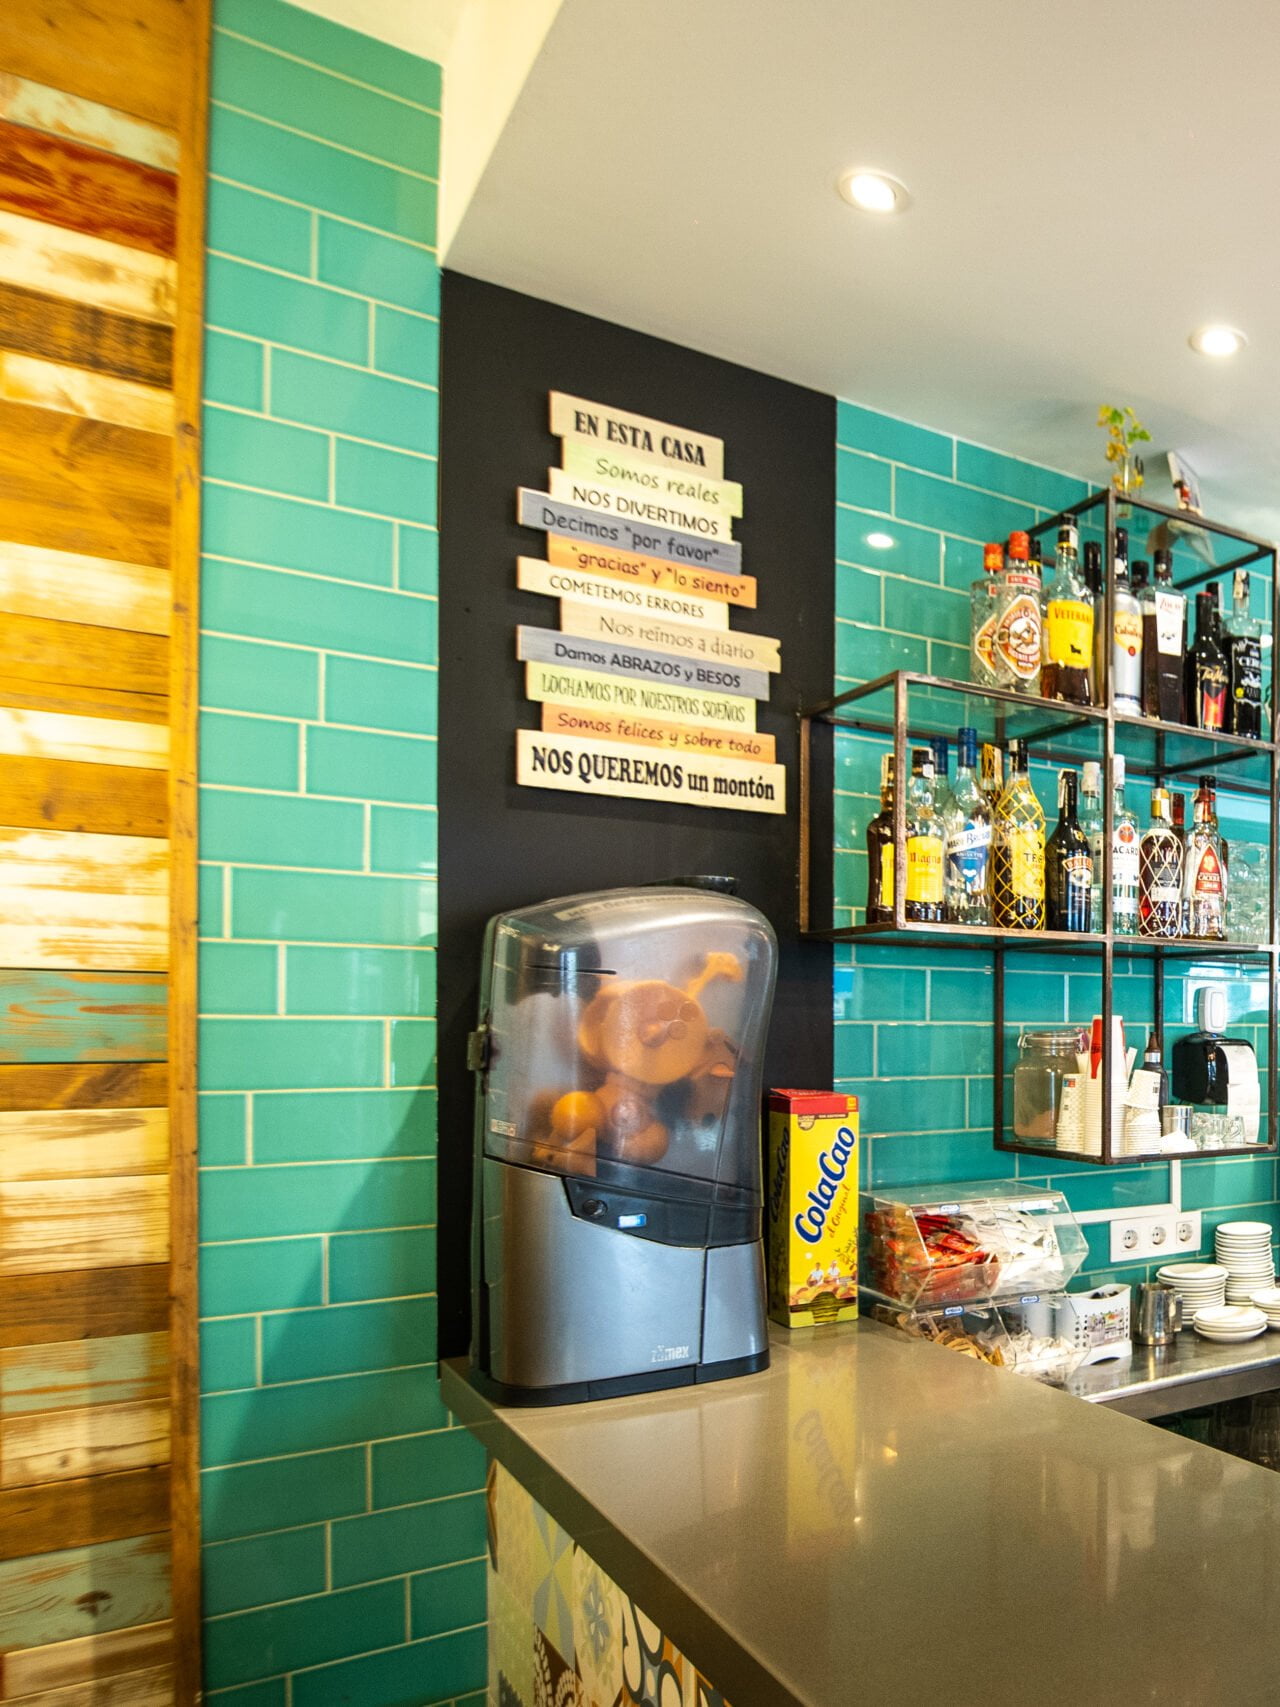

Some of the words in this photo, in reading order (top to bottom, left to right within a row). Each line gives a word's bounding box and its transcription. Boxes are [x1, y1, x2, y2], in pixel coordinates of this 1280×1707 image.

[574, 410, 599, 437] EN
[607, 419, 654, 452] ESTA
[661, 437, 707, 467] CASA
[596, 459, 660, 489] Somos
[667, 480, 720, 505] reales
[542, 507, 618, 541] Decimos
[573, 486, 611, 508] NOS
[617, 496, 720, 536] DIVERTIMOS
[550, 575, 643, 606] COMETEMOS
[647, 596, 705, 618] ERRORES
[651, 569, 663, 583] y
[599, 616, 634, 637] Nos
[698, 638, 706, 653] a
[711, 637, 755, 661] diario
[555, 643, 606, 665] Damos
[610, 653, 681, 678] ABRAZOS
[683, 669, 693, 682] y
[697, 668, 741, 689] BESOS
[614, 687, 637, 706] POR
[558, 713, 612, 734] Somos
[618, 720, 664, 741] felices
[669, 732, 680, 745] y
[684, 733, 722, 750] sobre
[729, 738, 762, 756] todo
[531, 746, 573, 776] NOS
[578, 753, 684, 790] QUEREMOS
[688, 773, 709, 792] un
[713, 775, 775, 801] montón
[795, 1126, 856, 1244] ColaCao
